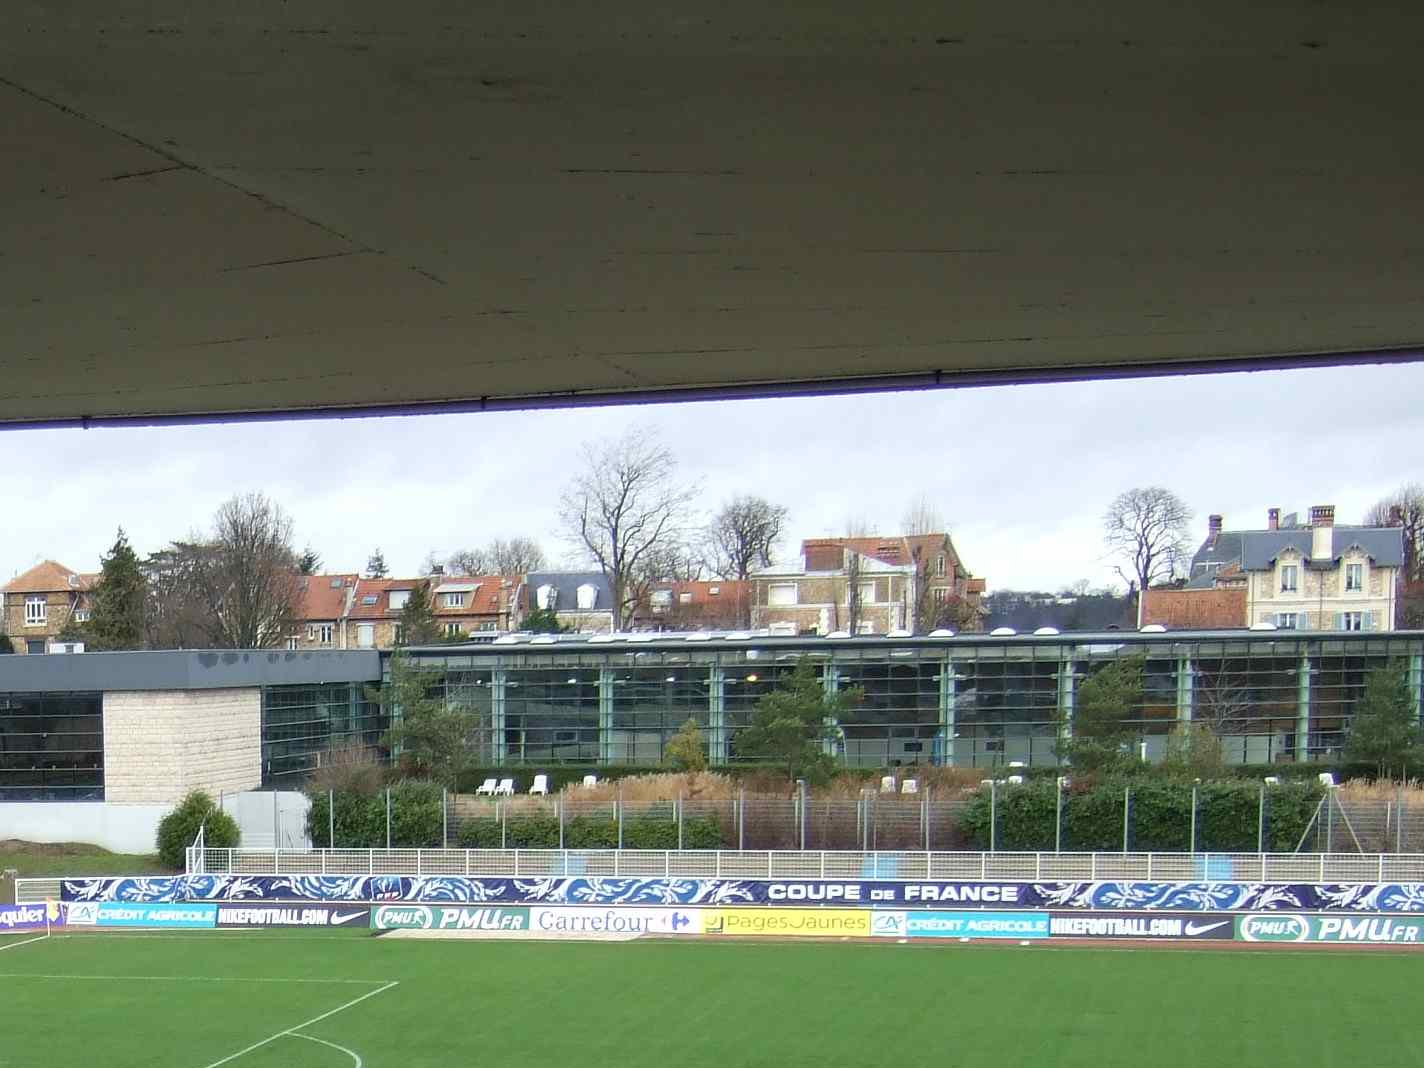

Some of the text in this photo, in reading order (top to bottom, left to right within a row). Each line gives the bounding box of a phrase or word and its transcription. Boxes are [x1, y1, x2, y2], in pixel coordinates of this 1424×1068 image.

[768, 884, 1019, 902] COUPE DE FRANCE
[146, 909, 215, 922] AGRICOLE
[217, 907, 329, 925] NIKEFOOTBALL.COM
[539, 910, 654, 933] Carrefour
[965, 918, 1048, 933] AGRICOLE
[1049, 917, 1182, 936] NIKEFOOTBALL.COM
